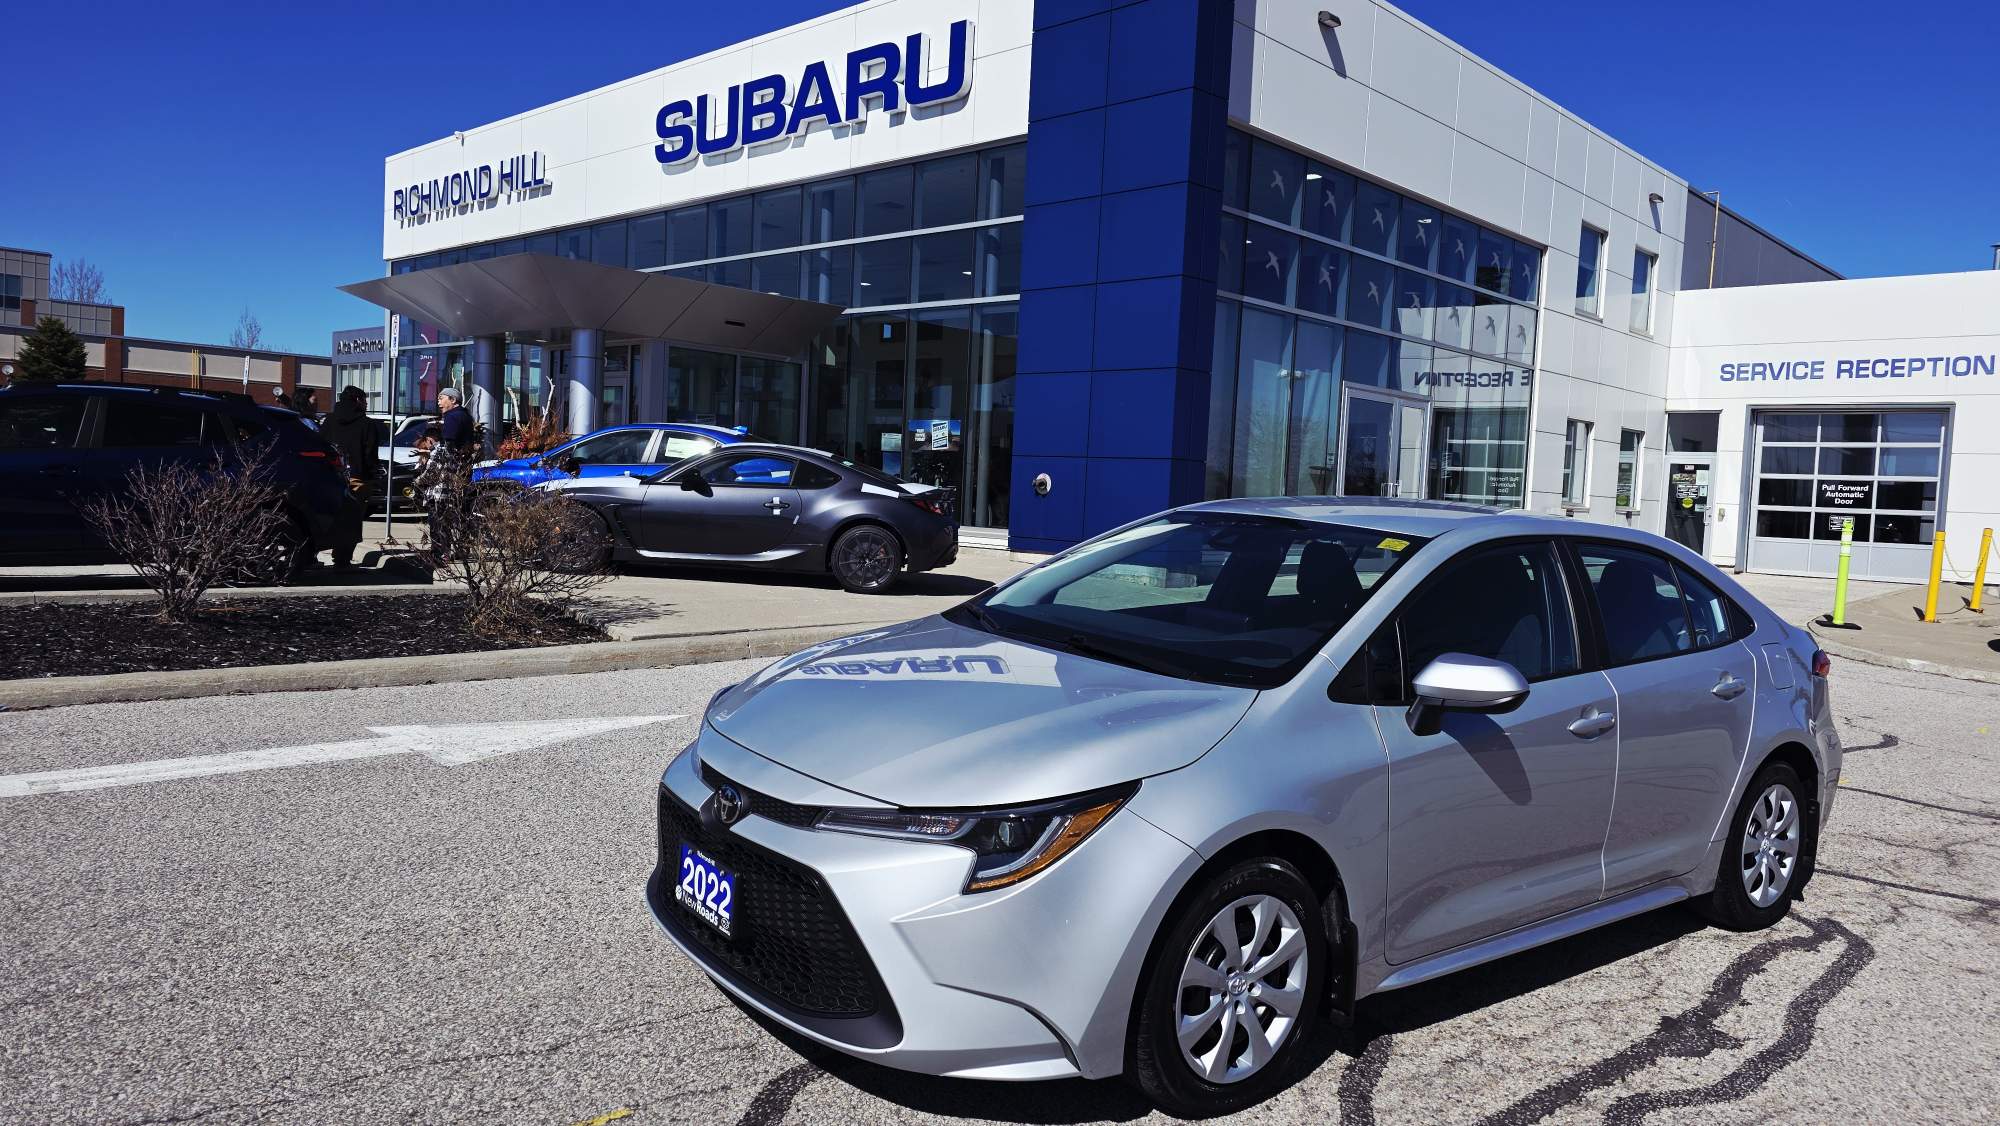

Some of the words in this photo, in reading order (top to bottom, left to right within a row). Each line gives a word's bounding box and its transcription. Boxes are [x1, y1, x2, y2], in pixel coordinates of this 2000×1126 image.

[655, 20, 969, 164] SUBARU
[394, 165, 492, 221] RICHMOND
[499, 151, 545, 197] HILL
[1720, 361, 1825, 383] SERVICE
[1836, 355, 1996, 380] RECEPTION
[1838, 484, 1869, 492] Forward
[682, 857, 730, 919] 2022
